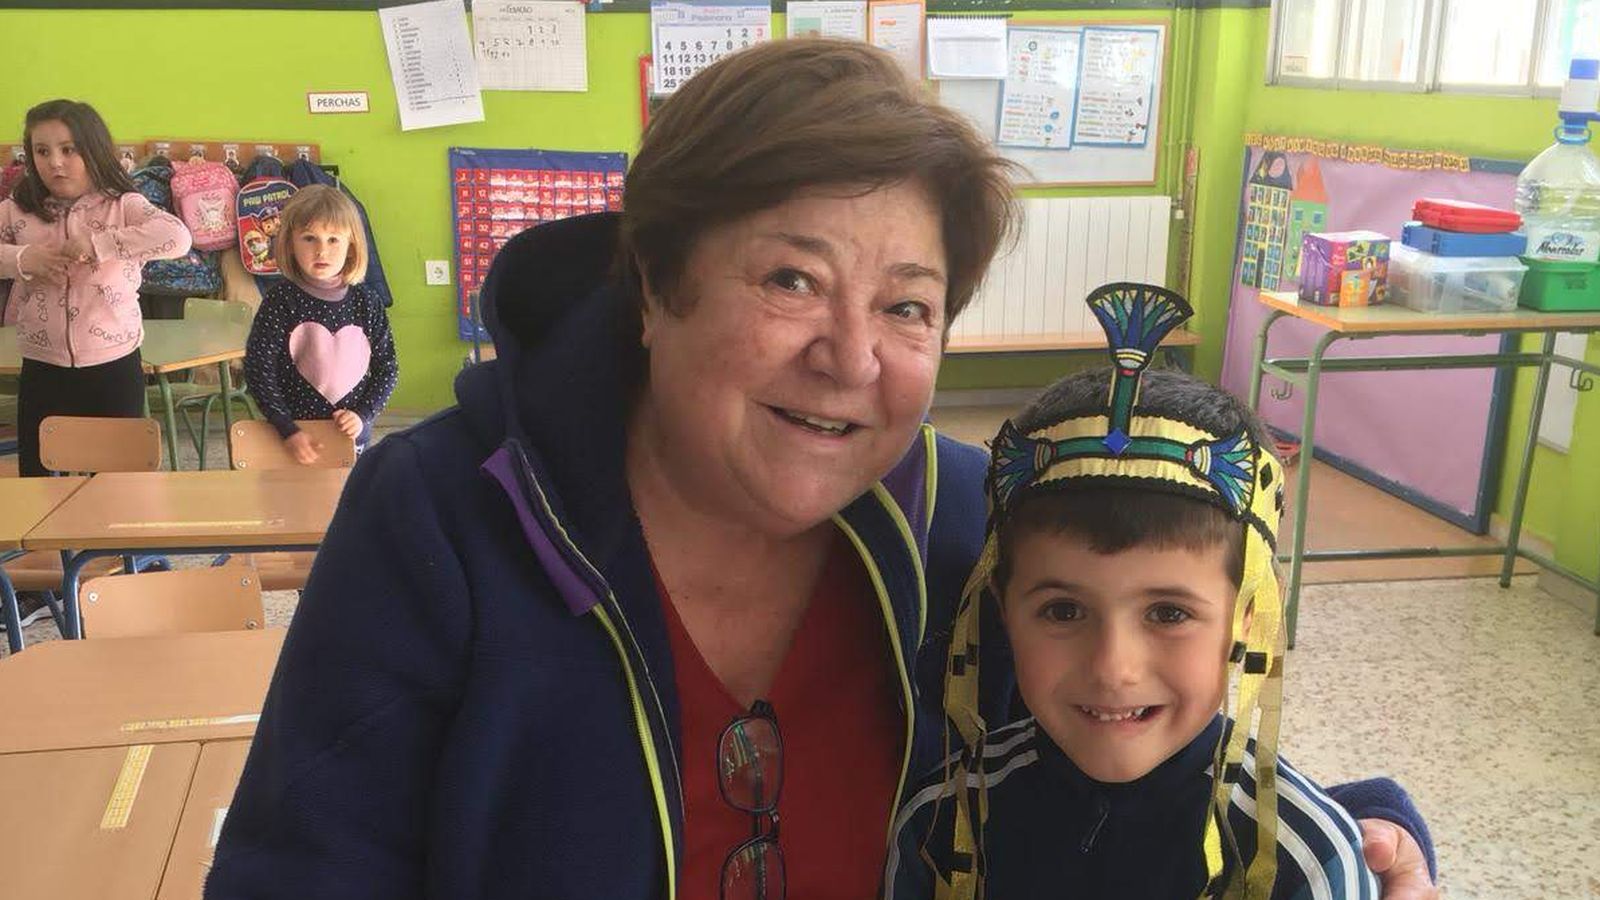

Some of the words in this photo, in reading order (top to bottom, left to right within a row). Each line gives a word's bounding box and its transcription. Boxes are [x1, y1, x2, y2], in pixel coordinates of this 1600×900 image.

[726, 28, 731, 37] 1
[741, 28, 748, 37] 2
[756, 28, 763, 37] 3
[665, 41, 671, 50] 4
[681, 41, 687, 51] 5
[695, 41, 702, 50] 6
[711, 41, 717, 50] 7
[727, 41, 733, 50] 8
[663, 54, 674, 63] 11
[679, 54, 690, 63] 12
[694, 54, 706, 63] 13
[664, 66, 676, 76] 18
[679, 66, 691, 76] 19
[664, 79, 677, 88] 25
[317, 97, 361, 108] PERCHAS
[243, 196, 262, 207] PAW
